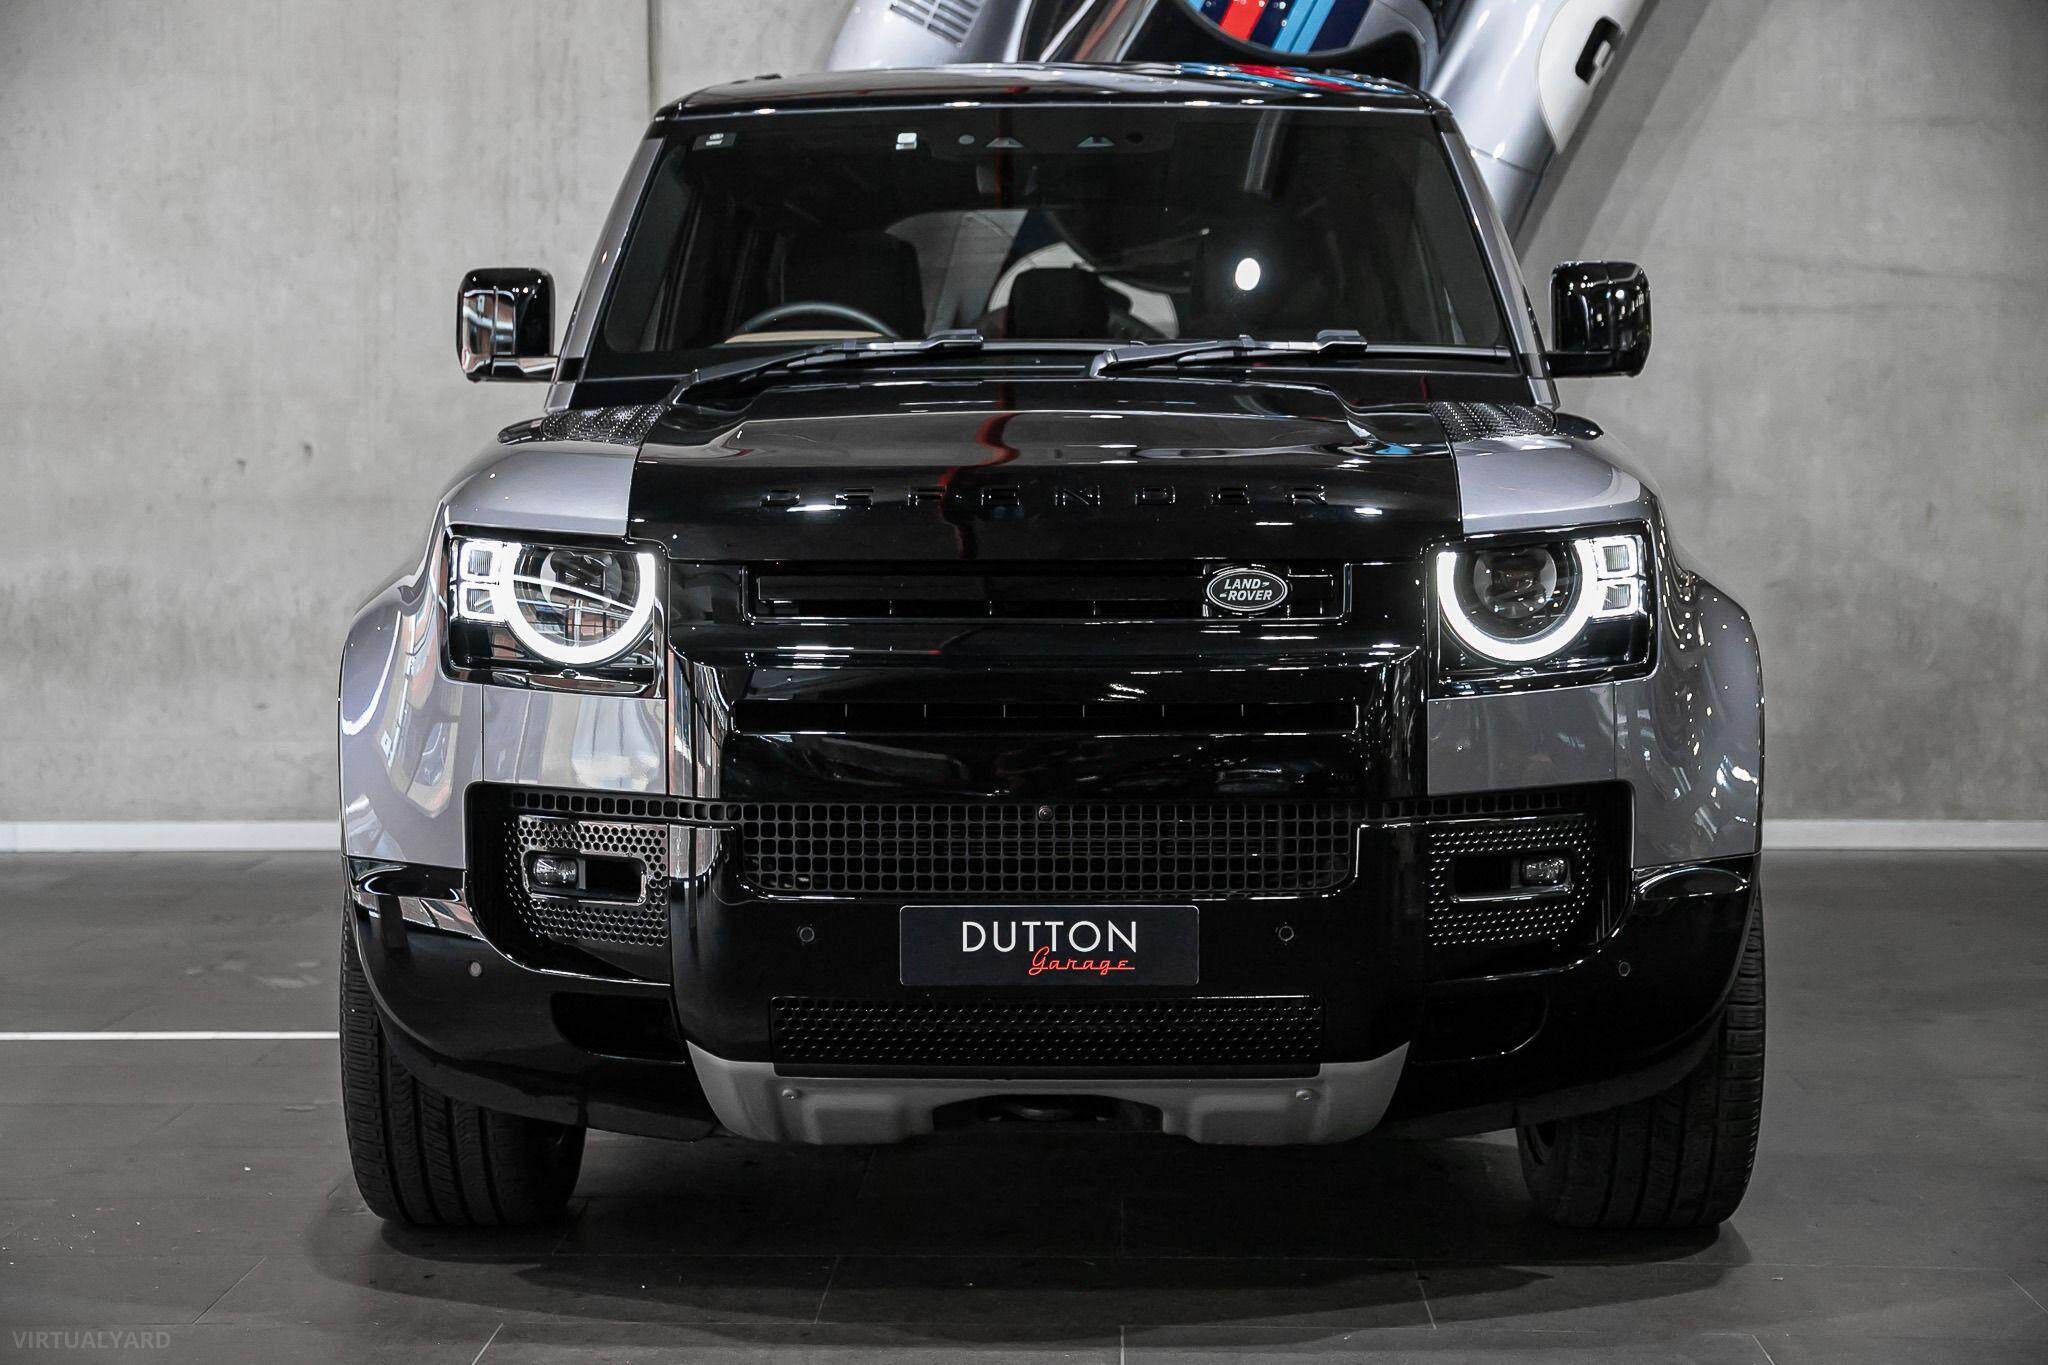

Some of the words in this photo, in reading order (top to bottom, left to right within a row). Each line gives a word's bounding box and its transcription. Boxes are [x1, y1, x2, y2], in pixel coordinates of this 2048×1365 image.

[1224, 578, 1261, 590] LAND
[1227, 589, 1273, 601] ROVER
[962, 920, 1137, 952] DUTTON
[1028, 945, 1136, 976] Garage
